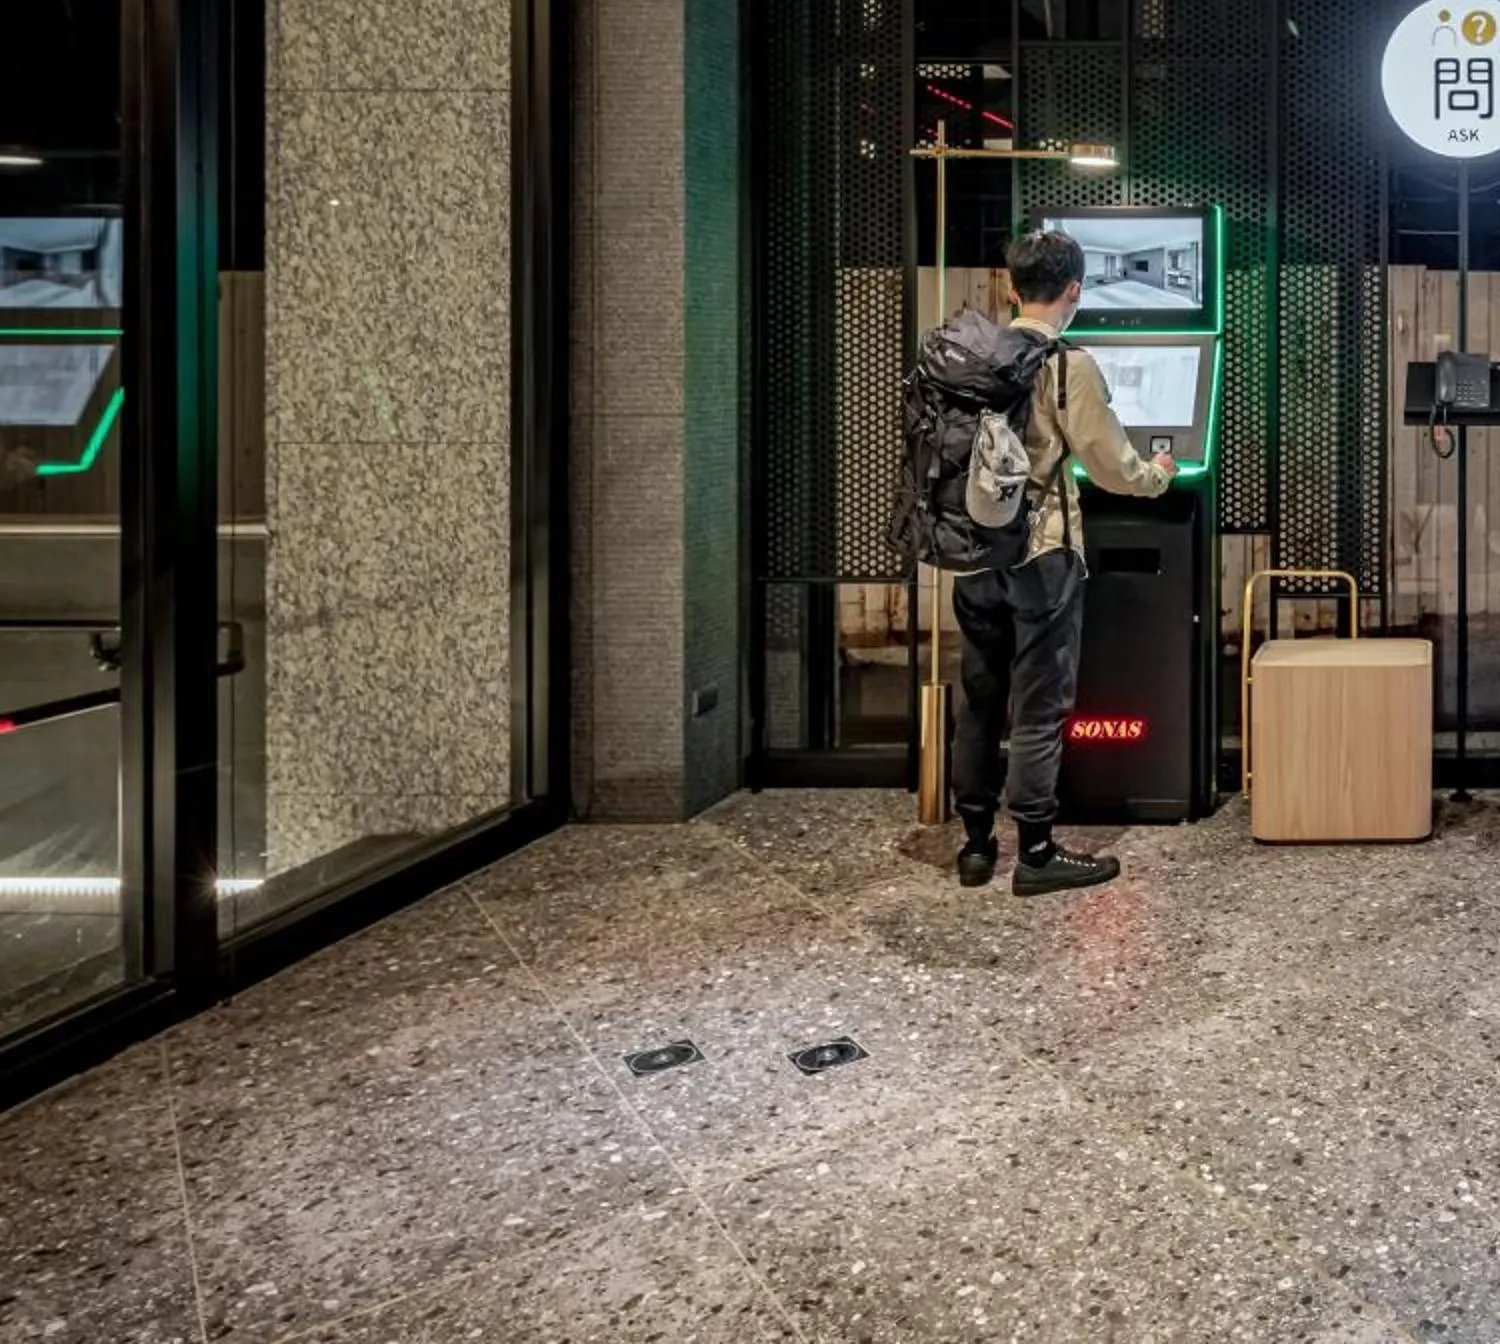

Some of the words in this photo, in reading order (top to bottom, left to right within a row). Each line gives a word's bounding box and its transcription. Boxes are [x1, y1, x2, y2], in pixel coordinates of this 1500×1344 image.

[1434, 57, 1494, 121] 問
[1447, 129, 1480, 143] ASK
[1070, 719, 1143, 739] SONAS
